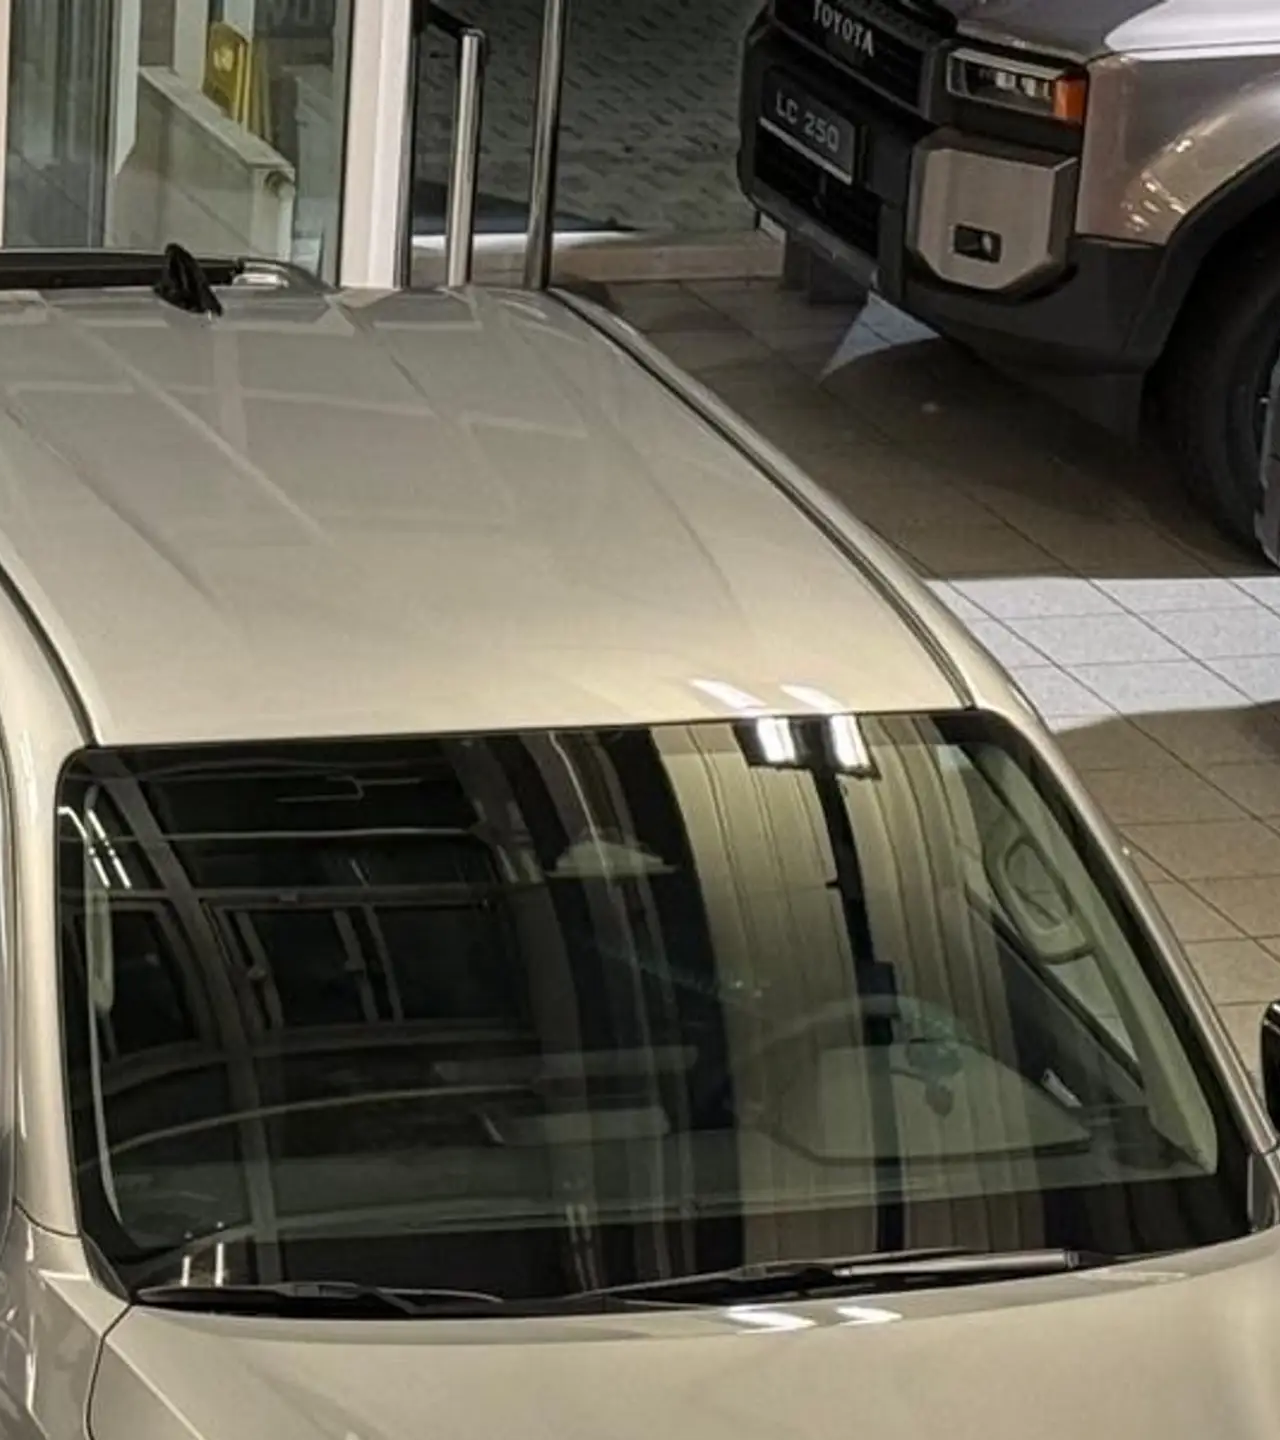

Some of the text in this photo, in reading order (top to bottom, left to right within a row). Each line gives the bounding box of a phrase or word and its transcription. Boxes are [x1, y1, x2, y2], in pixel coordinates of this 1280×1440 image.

[813, 0, 874, 57] TOYOTA
[776, 89, 839, 154] LC 250
